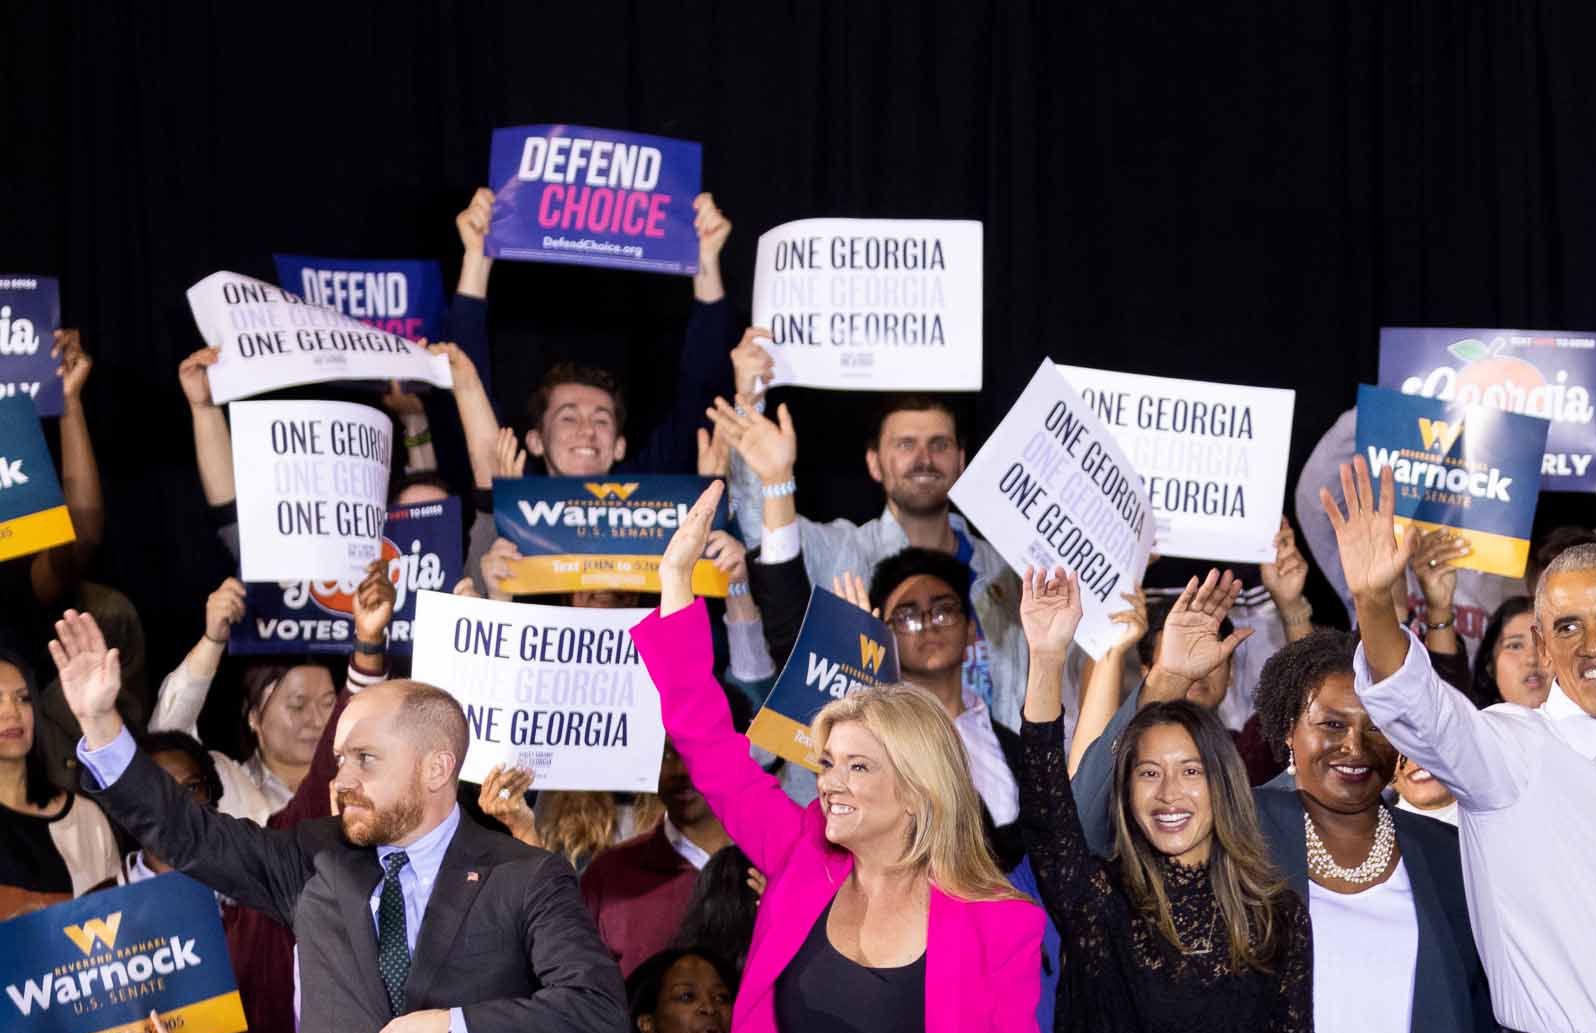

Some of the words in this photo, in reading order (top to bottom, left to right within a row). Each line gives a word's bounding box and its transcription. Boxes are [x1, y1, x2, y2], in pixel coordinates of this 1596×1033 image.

[517, 136, 662, 191] DEFEND
[537, 184, 672, 238] CHOICE
[542, 235, 643, 257] DefendChoice.org
[775, 237, 823, 271] ONE
[830, 236, 945, 270] GEORGIA
[222, 282, 277, 305] ONE
[301, 267, 408, 317] DEFEND
[237, 331, 292, 358] ONE
[296, 329, 412, 354] GEORGIA
[771, 312, 822, 346] ONE
[830, 312, 945, 346] GEORGIA
[271, 419, 325, 455] ONE
[1137, 394, 1253, 440] GEORGIA
[1044, 400, 1089, 458] ONE
[1081, 441, 1147, 542] GEORGIA
[1367, 446, 1512, 502] Warnock
[1541, 453, 1592, 476] RLY
[1140, 474, 1246, 519] EORGIA
[277, 500, 330, 536] ONE
[610, 527, 664, 538] SENATE
[998, 463, 1048, 521] ONE
[1035, 502, 1121, 604] GEORGIA
[255, 618, 349, 641] VOTES
[453, 616, 513, 659] ONE
[519, 624, 640, 666] GEORGIA
[466, 704, 503, 744] NE
[510, 708, 629, 748] GEORGIA
[6, 935, 201, 1017] Warnock
[73, 998, 104, 1016] U.S.
[109, 979, 165, 1001] SENATE
